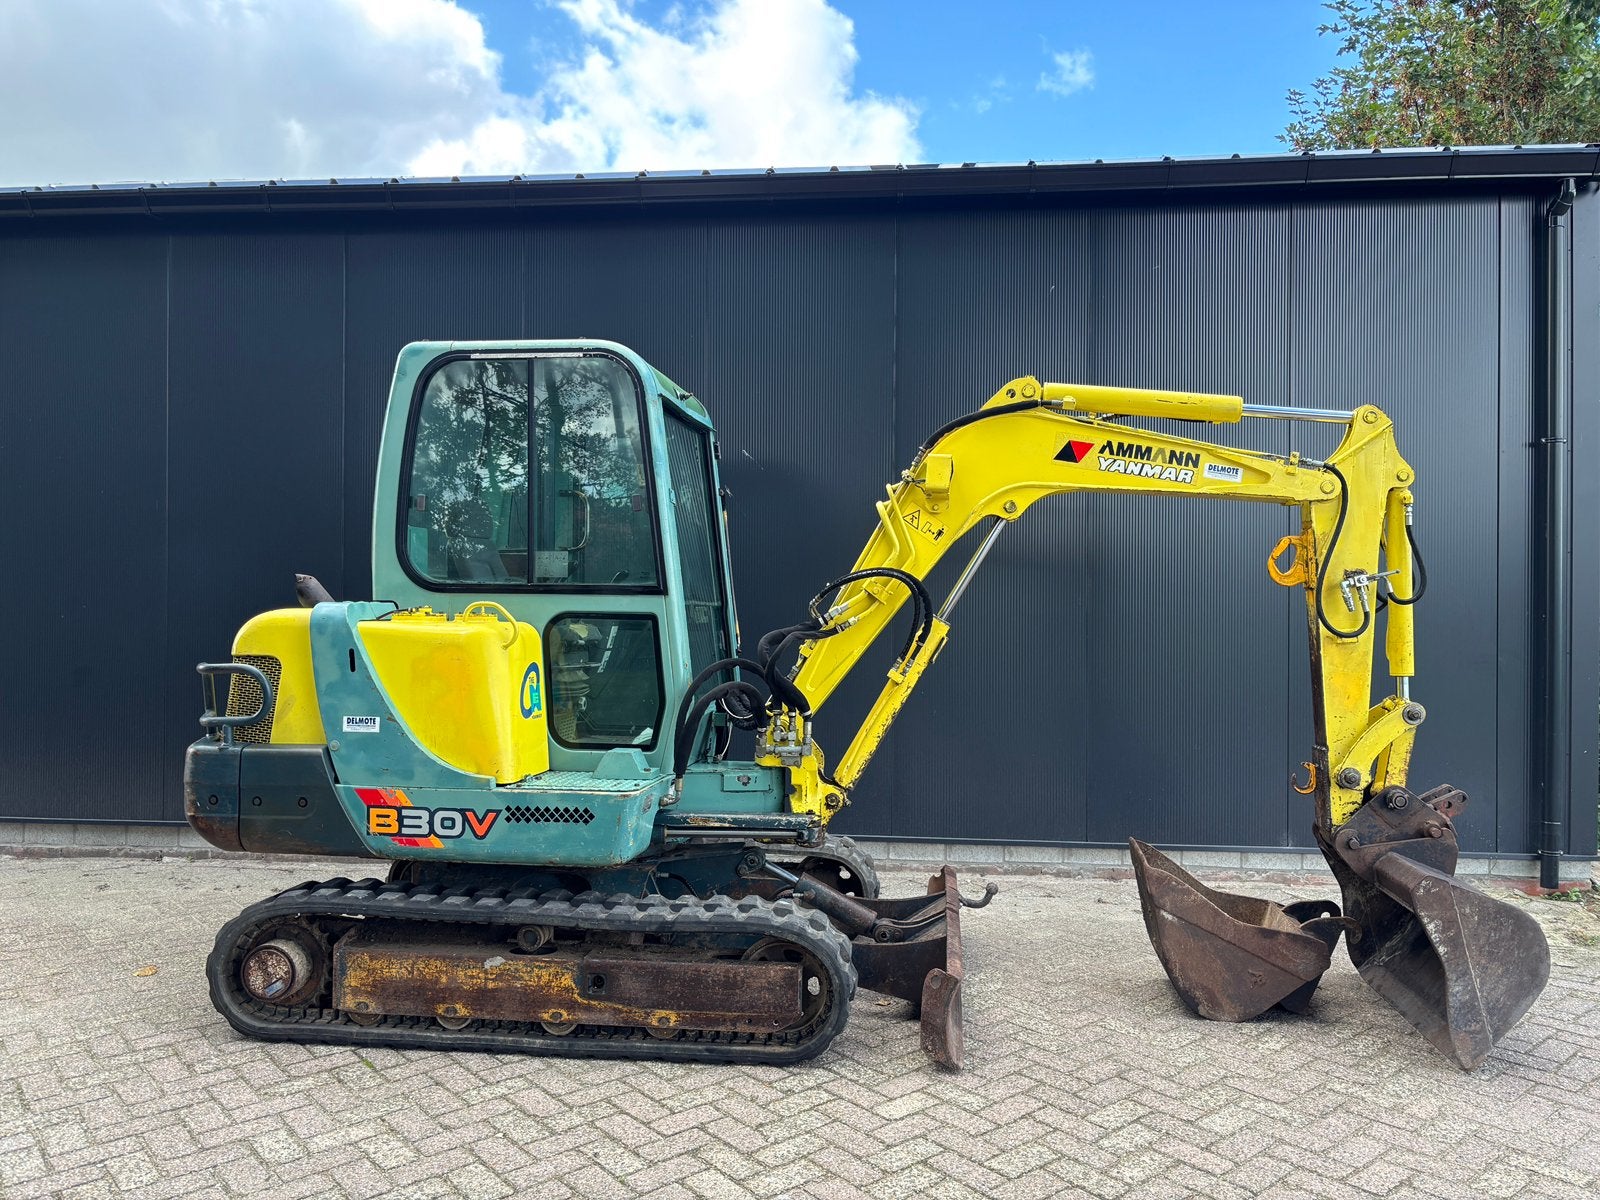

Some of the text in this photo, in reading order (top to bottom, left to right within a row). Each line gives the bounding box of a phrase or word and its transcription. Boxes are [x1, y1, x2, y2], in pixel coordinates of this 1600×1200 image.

[1098, 440, 1200, 468] AMMANN
[1098, 456, 1194, 484] YANMAR
[1208, 463, 1240, 475] DELMOTE
[346, 717, 376, 725] DELMOTE
[367, 805, 502, 840] B30V
